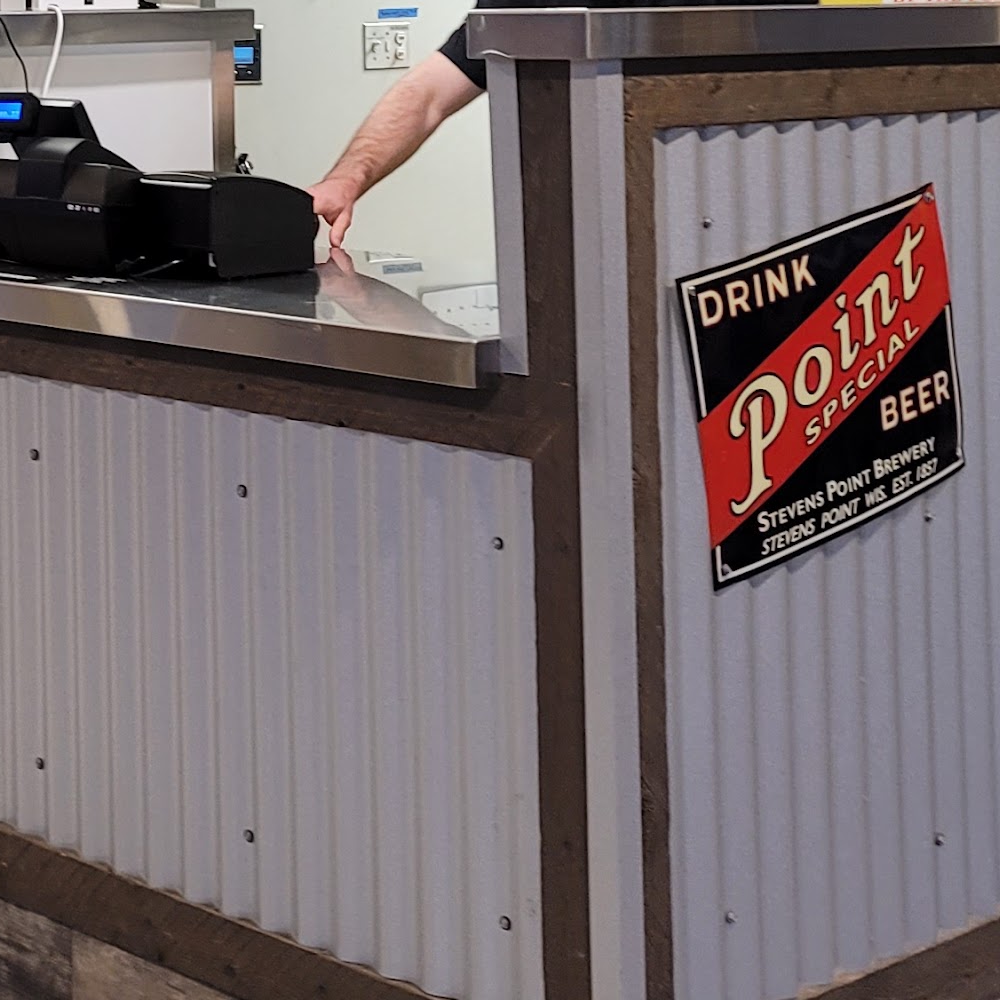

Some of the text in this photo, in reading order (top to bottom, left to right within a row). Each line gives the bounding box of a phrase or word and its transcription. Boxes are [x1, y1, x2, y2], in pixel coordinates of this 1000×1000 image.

[697, 254, 817, 327] DRINK
[729, 223, 925, 515] Point
[805, 318, 921, 446] SPECIAL
[880, 369, 951, 432] BEER
[757, 436, 936, 533] STEVENS POINT BREWERY
[761, 521, 816, 556] STEVENS
[820, 500, 861, 528] POINT
[915, 457, 939, 484] 1857
